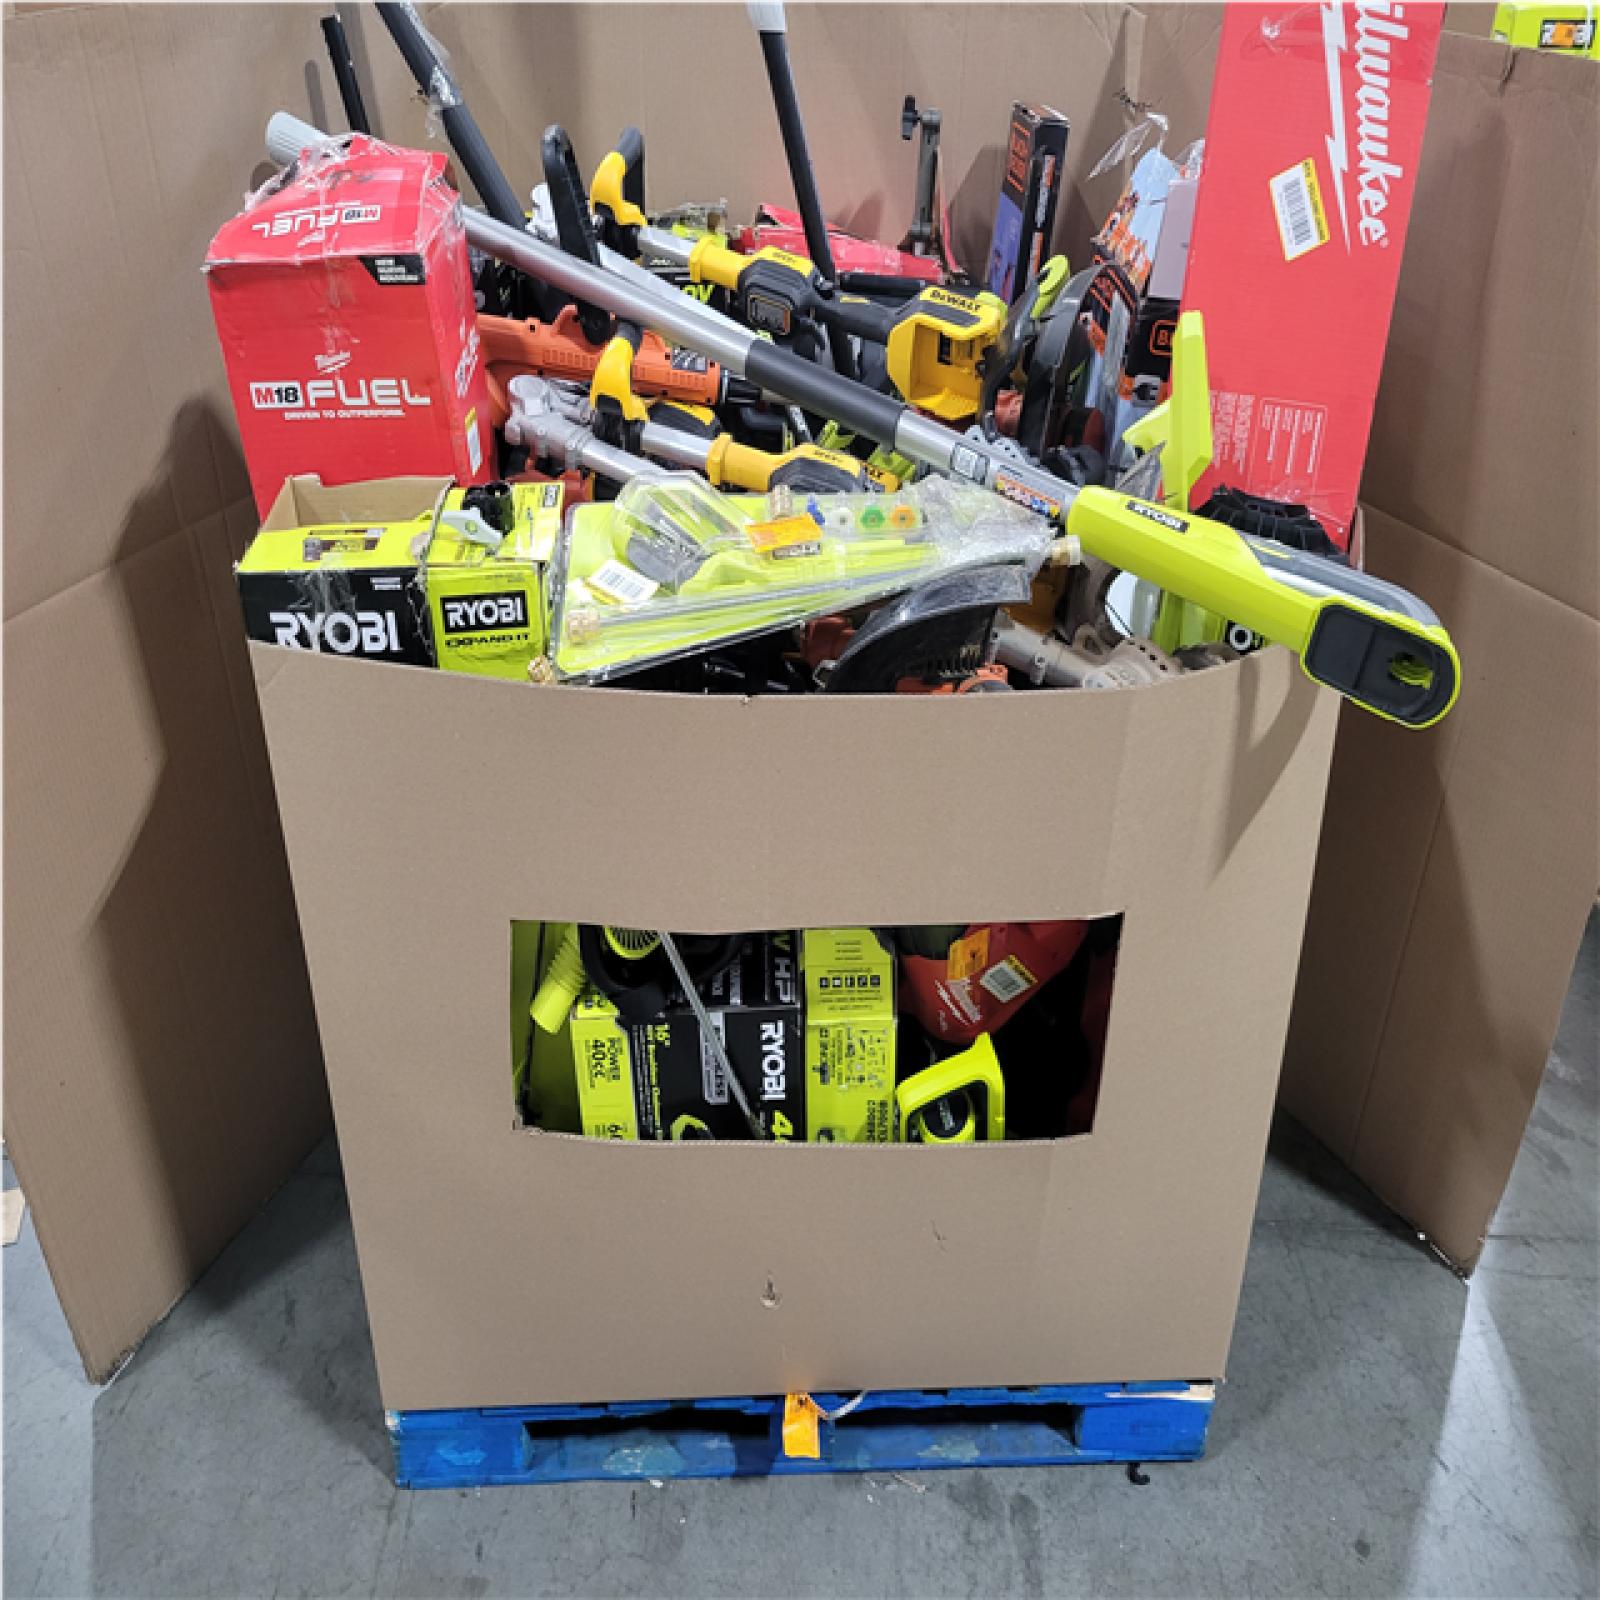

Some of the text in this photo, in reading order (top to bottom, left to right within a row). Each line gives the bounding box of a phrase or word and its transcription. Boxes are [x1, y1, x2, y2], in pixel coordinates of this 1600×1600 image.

[1355, 0, 1409, 247] ilwaukee
[251, 378, 431, 407] M18 FUEL
[269, 611, 399, 653] RYOBI
[444, 597, 524, 628] RYOBI
[760, 1019, 785, 1101] RYOBI
